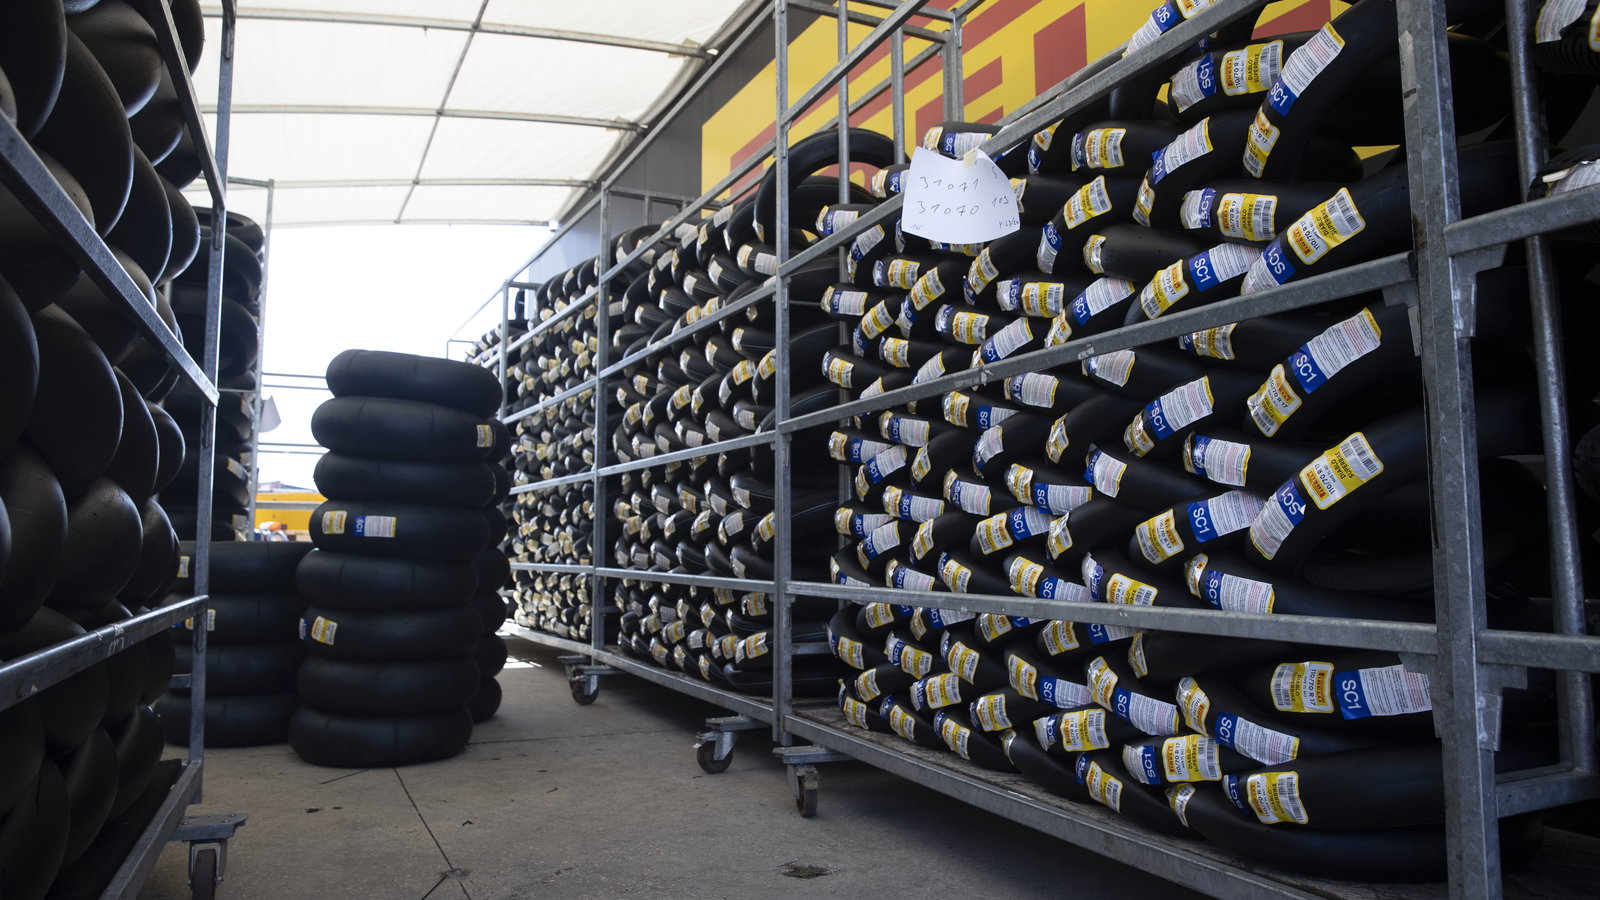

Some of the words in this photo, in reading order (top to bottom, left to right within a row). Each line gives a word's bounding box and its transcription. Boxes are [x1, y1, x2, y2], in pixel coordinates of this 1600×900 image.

[1156, 7, 1170, 23] SC
[1200, 62, 1212, 89] SC1
[1271, 82, 1288, 107] SC1
[917, 201, 980, 216] 31070
[1222, 202, 1231, 229] PIRELLI
[1246, 204, 1255, 232] SUPERBIKE
[1315, 216, 1330, 236] DIABLO
[1319, 209, 1338, 236] SUPERBIKE
[1292, 229, 1312, 255] PIRELLI
[1304, 230, 1321, 251] 110/70
[1194, 258, 1210, 283] SC1
[1267, 247, 1286, 274] SC1
[1073, 297, 1087, 318] SC1
[985, 341, 996, 361] SC1
[1296, 354, 1318, 383] SC1
[1275, 375, 1292, 402] PIRELLI
[980, 411, 988, 430] SC1
[1151, 407, 1167, 432] SC1
[852, 442, 860, 459] SC1
[868, 459, 878, 478] SC1
[1330, 458, 1346, 480] DIABLO
[1334, 451, 1354, 479] SUPERBIKE
[1306, 470, 1326, 498] PIRELLI
[1319, 473, 1336, 495] 110/70
[1037, 489, 1048, 509] SC1
[1281, 488, 1300, 516] SC1
[855, 519, 863, 535] SC1
[1013, 513, 1025, 534] SC1
[1164, 518, 1177, 544] PIRELLI
[1193, 507, 1211, 531] SC1
[1044, 581, 1053, 597] SC
[1209, 578, 1219, 606] SC1
[1090, 622, 1103, 638] C1
[1043, 681, 1053, 703] SC1
[1341, 679, 1362, 709] SC1
[1118, 694, 1127, 717] SC1
[1220, 716, 1232, 745] SC1
[1144, 752, 1155, 778] SC1
[1258, 797, 1270, 816] 110/70
[1268, 790, 1277, 811] DIABLO
[1272, 784, 1285, 813] SUPERBIKE
